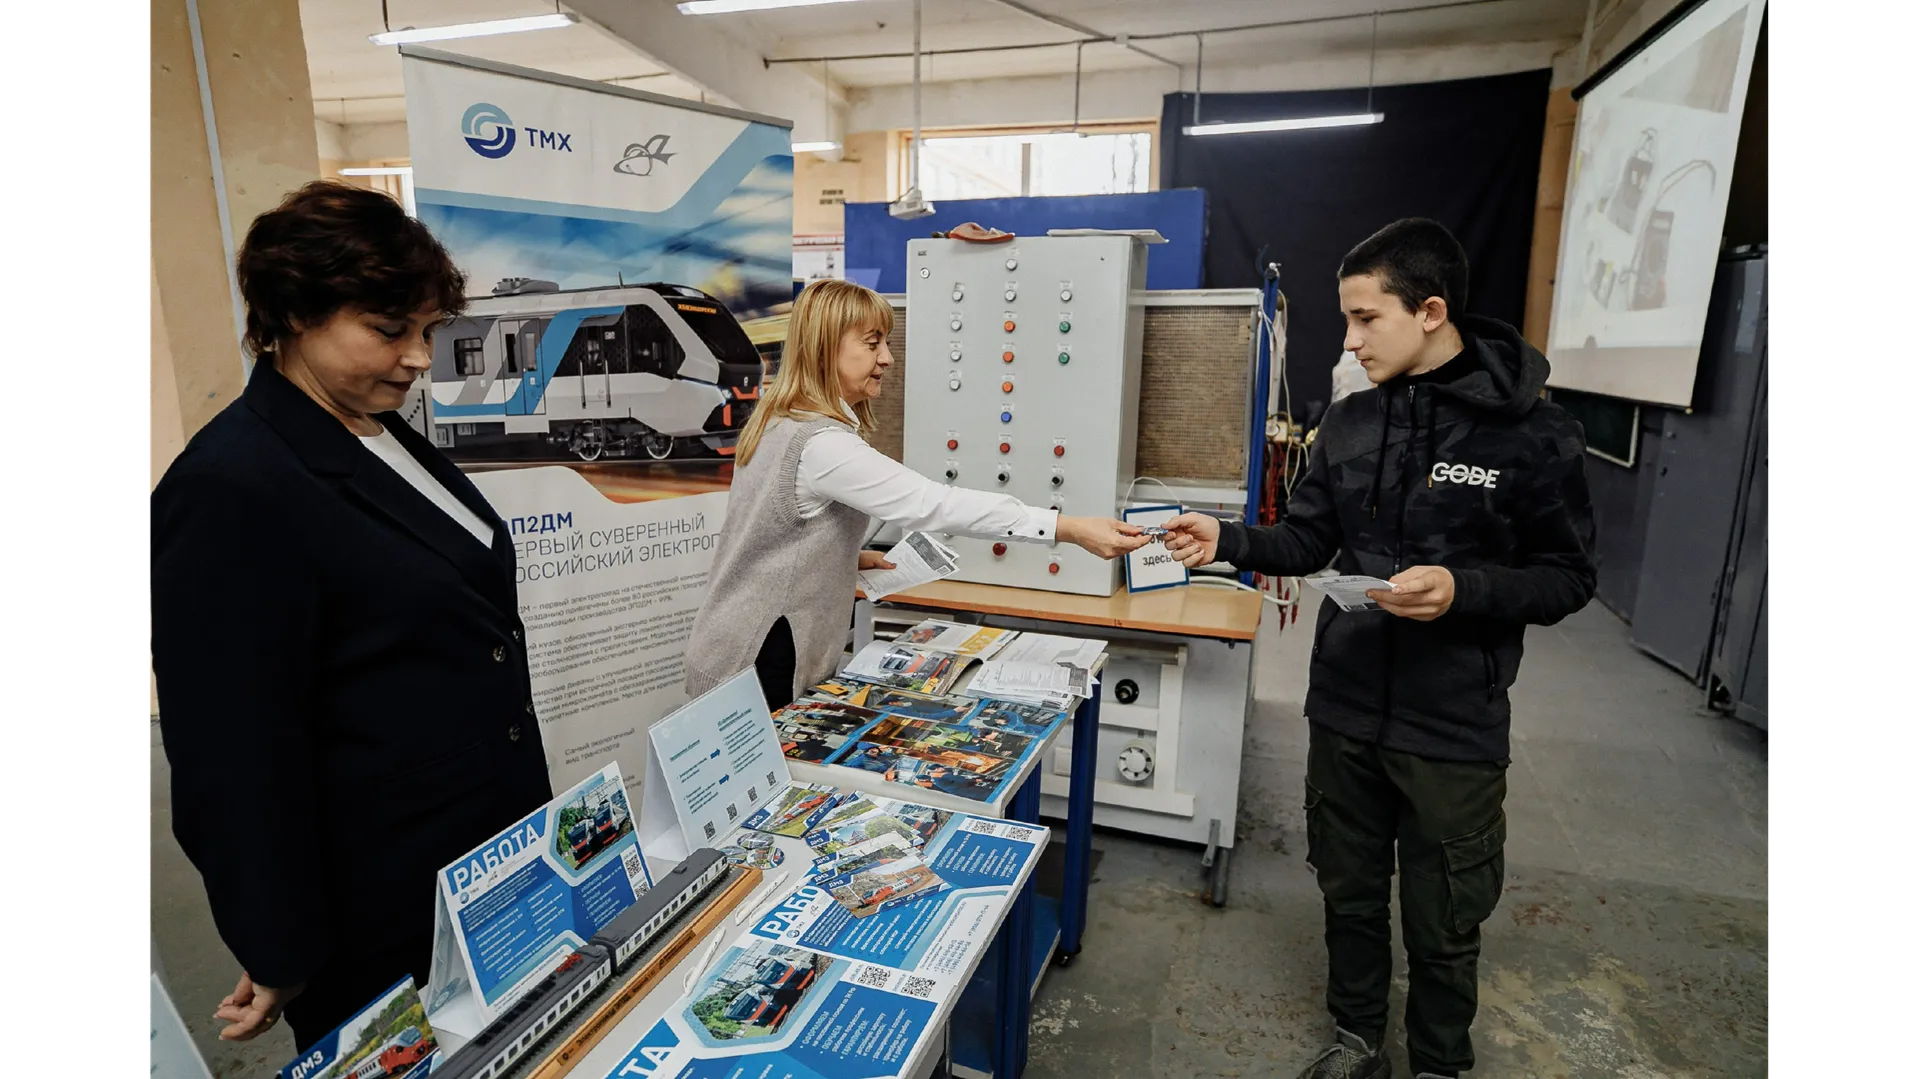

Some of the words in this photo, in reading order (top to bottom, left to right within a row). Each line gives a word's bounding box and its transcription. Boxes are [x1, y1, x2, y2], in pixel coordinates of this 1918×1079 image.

[525, 127, 573, 153] ТМХ
[1432, 462, 1500, 488] CODE
[509, 512, 573, 535] П2ДМ
[515, 532, 583, 560] ЕРВЫЙ
[590, 513, 704, 548] СУВЕРЕННЫЙ
[516, 547, 633, 584] ОССИЙСКИЙ
[639, 534, 720, 562] ЭЛЕКТРОП
[1143, 554, 1172, 566] здесь
[524, 610, 564, 622] созданию
[565, 602, 609, 614] привлечены
[611, 596, 630, 604] более
[642, 586, 679, 598] российских
[539, 598, 569, 609] первый
[571, 589, 620, 604] электропоезд
[631, 576, 678, 591] отечественной
[577, 606, 626, 620] производства
[527, 643, 537, 651] ий
[564, 690, 578, 698] при
[454, 824, 539, 889] РАБОТА
[760, 886, 818, 934] РАБО
[802, 1011, 829, 1044] ОФОРМЛЯЕМ
[822, 1025, 842, 1049] ОБУЧАЕМ
[292, 1051, 324, 1079] ДМЗ
[620, 1046, 673, 1079] ТА
